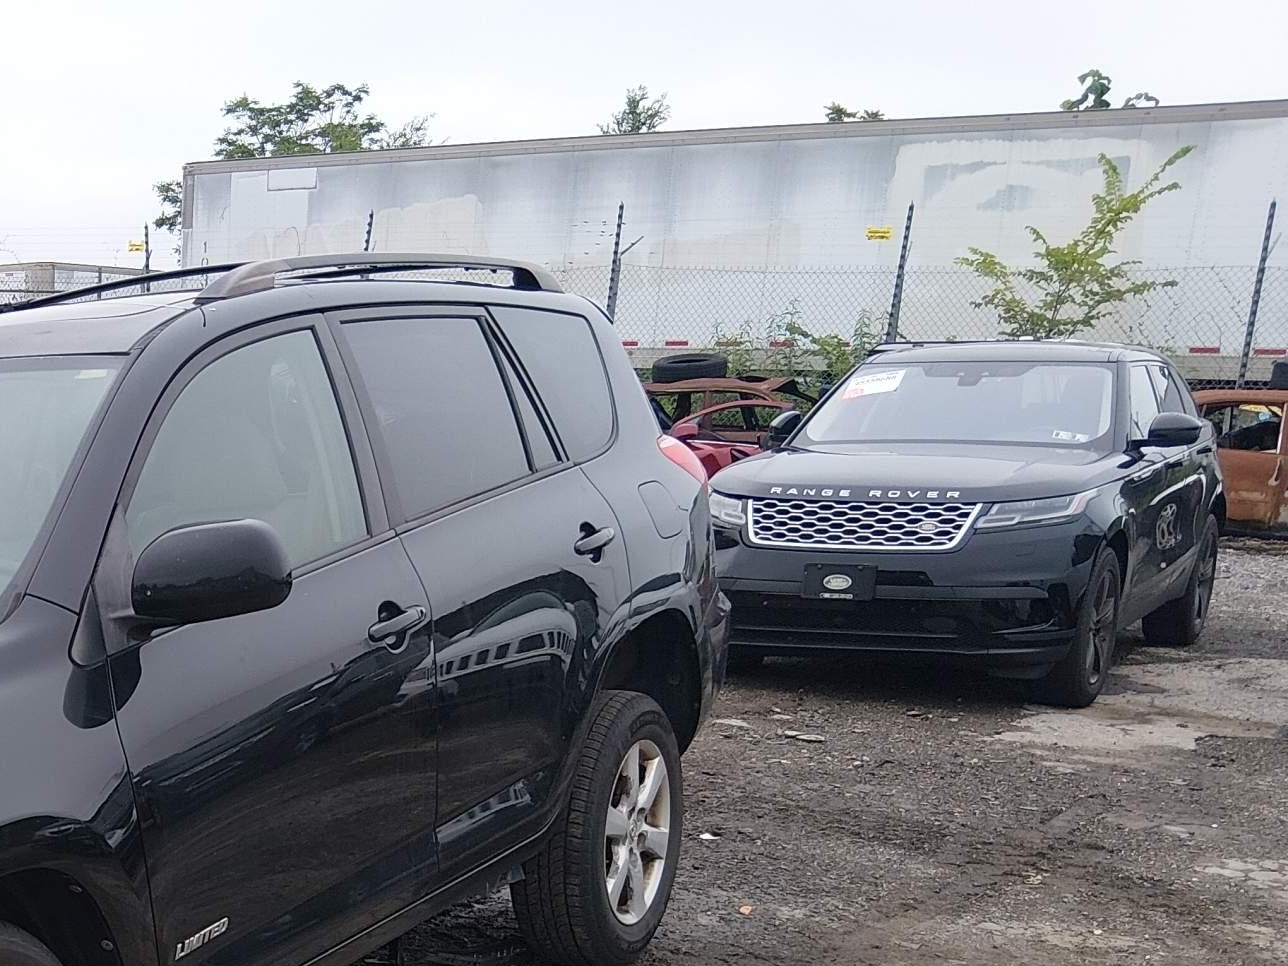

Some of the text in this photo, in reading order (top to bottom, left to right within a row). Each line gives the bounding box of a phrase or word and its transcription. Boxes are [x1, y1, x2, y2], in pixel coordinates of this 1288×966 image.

[770, 486, 961, 499] RANGE ROVER
[174, 916, 229, 961] LIMITED
